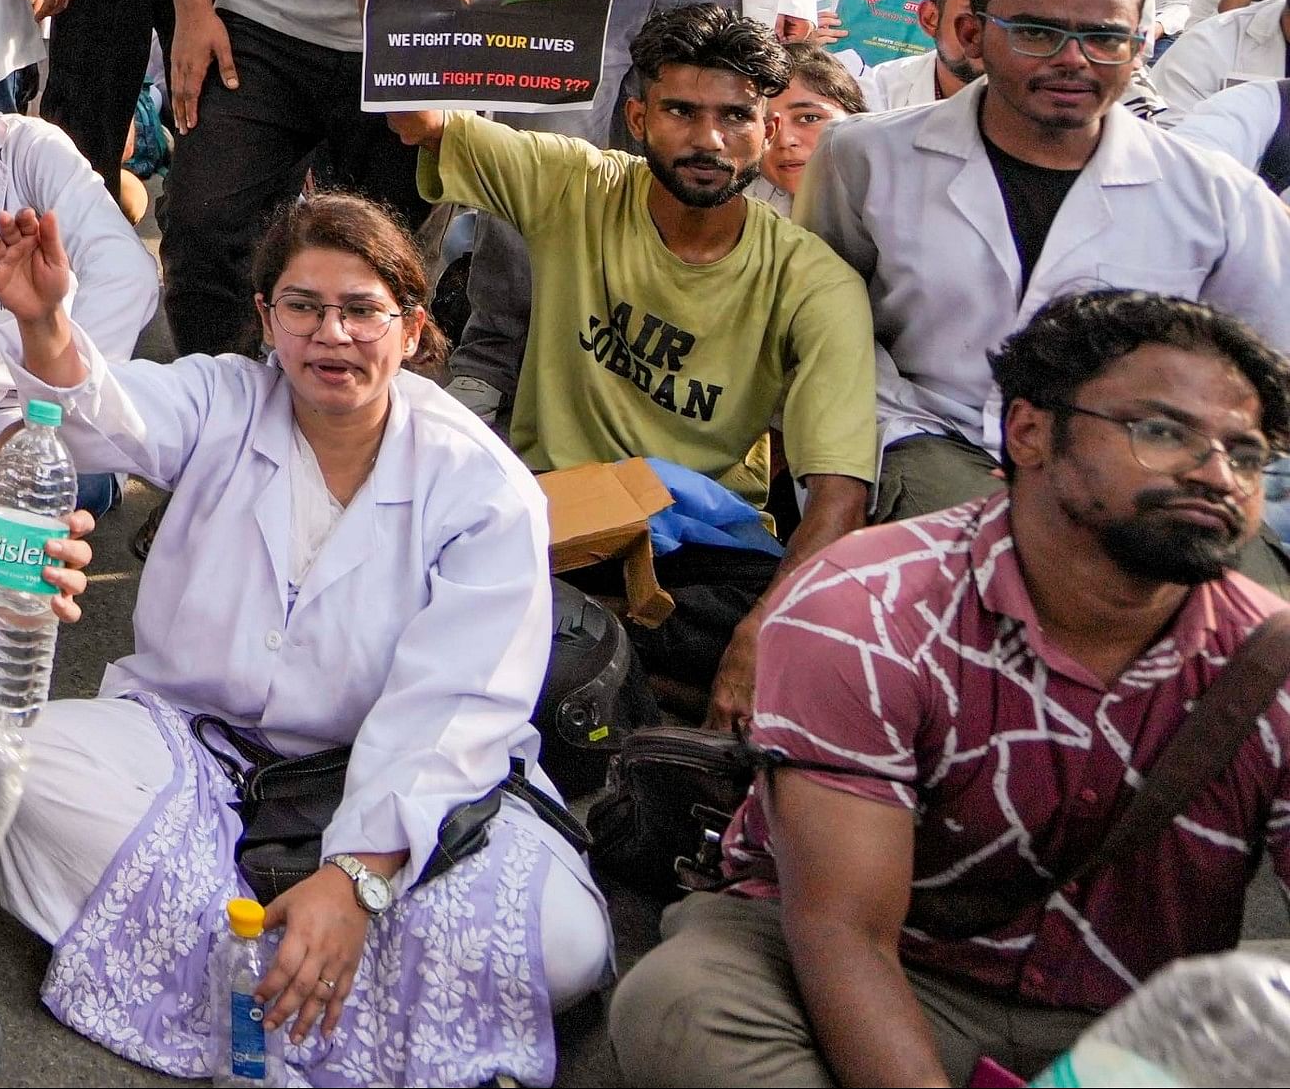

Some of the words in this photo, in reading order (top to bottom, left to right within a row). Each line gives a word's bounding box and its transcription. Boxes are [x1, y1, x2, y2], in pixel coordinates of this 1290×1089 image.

[388, 33, 410, 47] WE
[413, 33, 451, 47] FIGHT
[453, 33, 482, 47] FOR
[485, 34, 527, 50] YOUR
[529, 36, 575, 52] LIVES
[373, 73, 407, 87] WHO
[408, 72, 440, 86] WILL
[442, 72, 484, 86] FIGHT
[486, 73, 516, 87] FOR
[519, 75, 561, 91] OURS
[564, 78, 590, 93] ???
[610, 302, 696, 372] AIR
[579, 315, 724, 422] JORDAN
